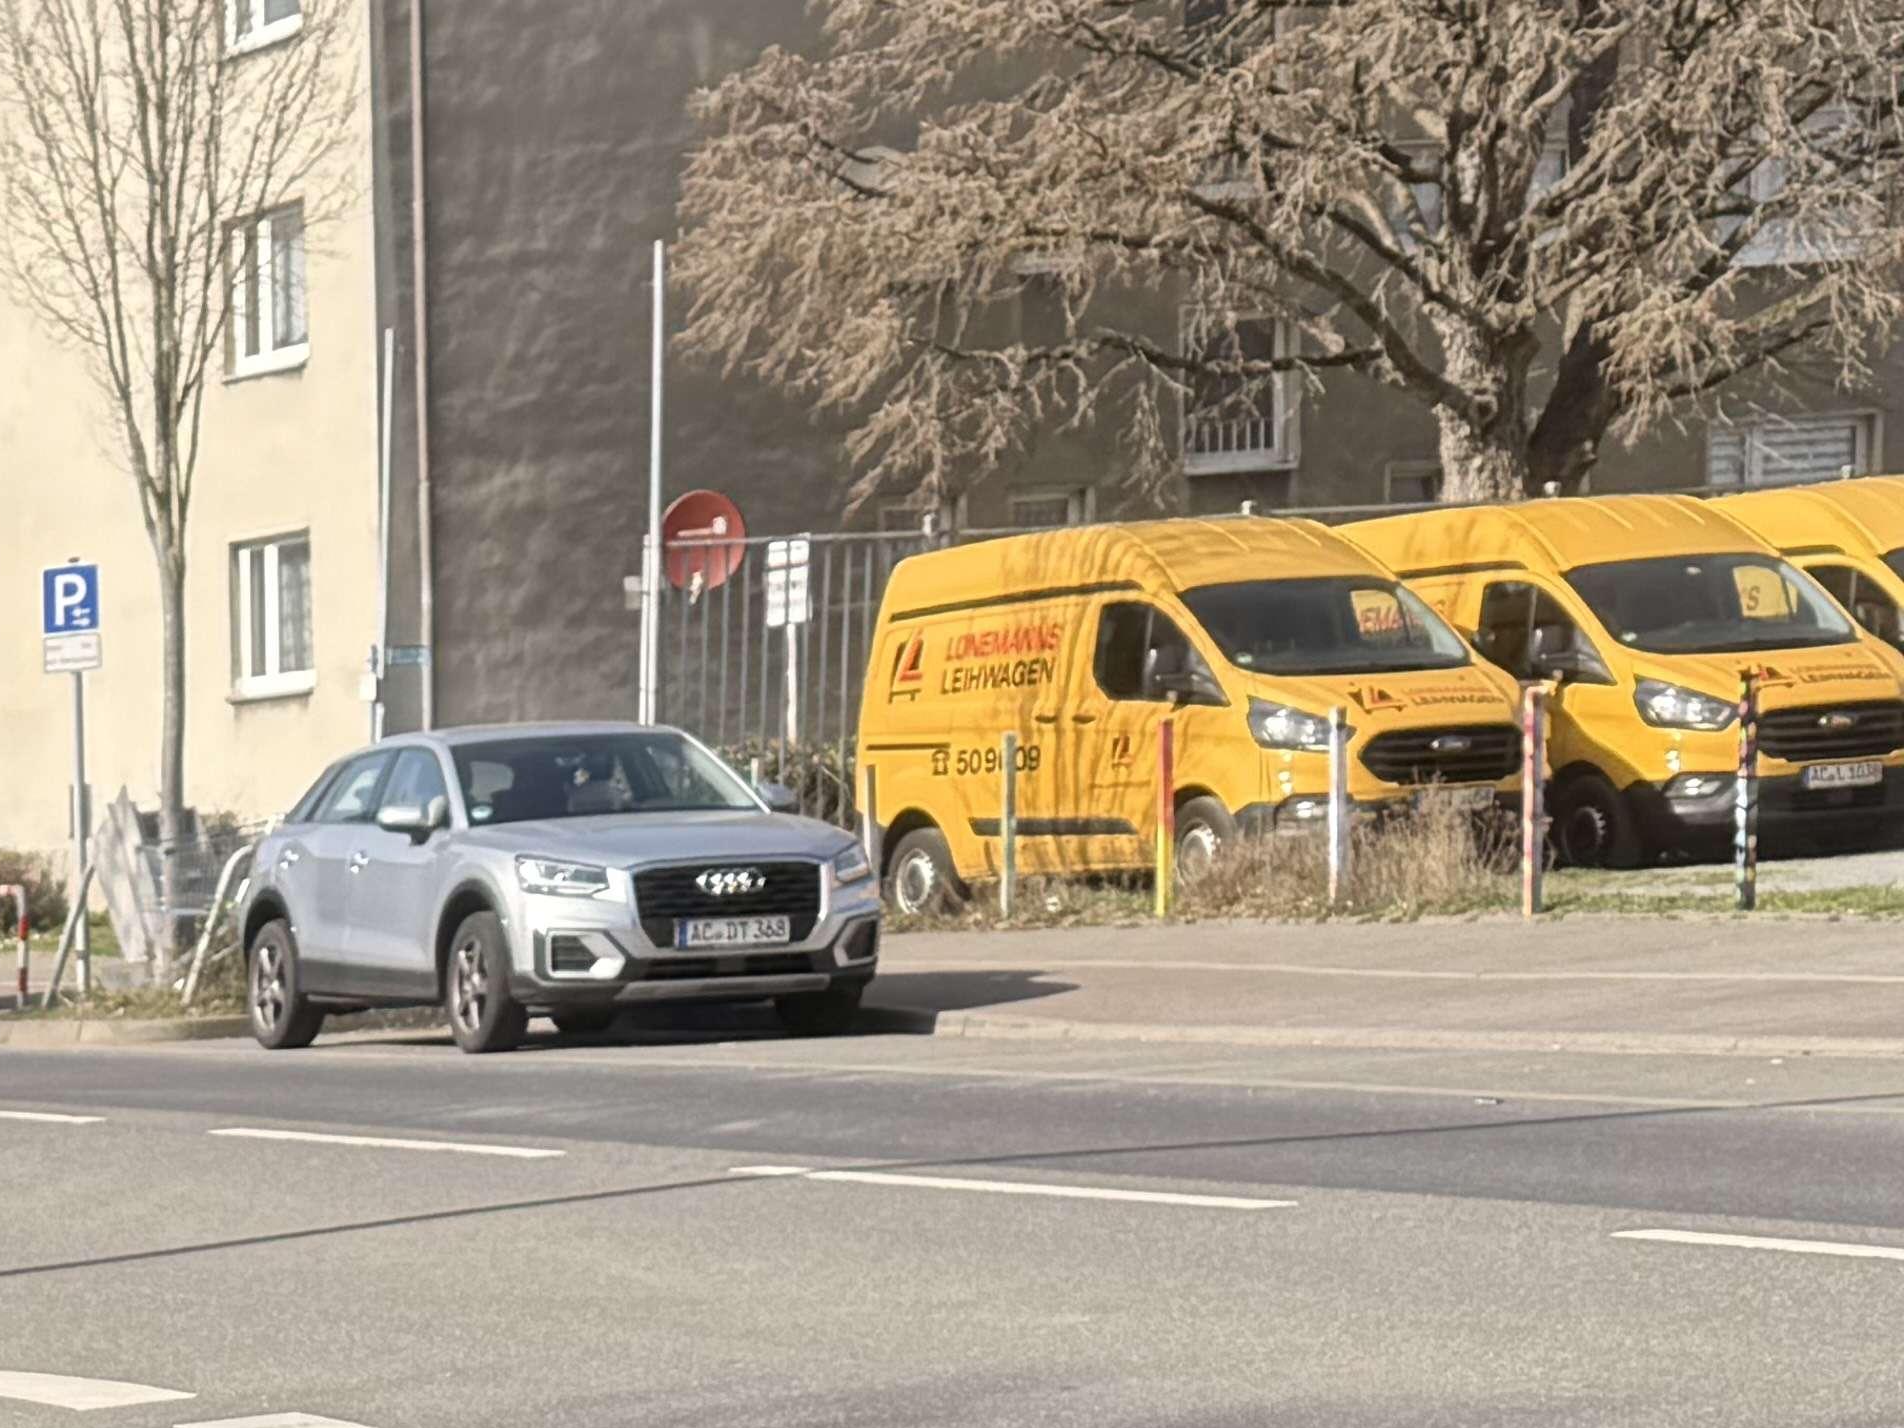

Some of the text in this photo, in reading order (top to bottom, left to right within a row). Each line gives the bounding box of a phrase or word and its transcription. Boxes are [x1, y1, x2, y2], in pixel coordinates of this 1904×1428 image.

[54, 573, 88, 626] P
[942, 658, 1055, 693] LEIHWAGEN
[692, 922, 713, 940] AC
[726, 921, 749, 940] DT
